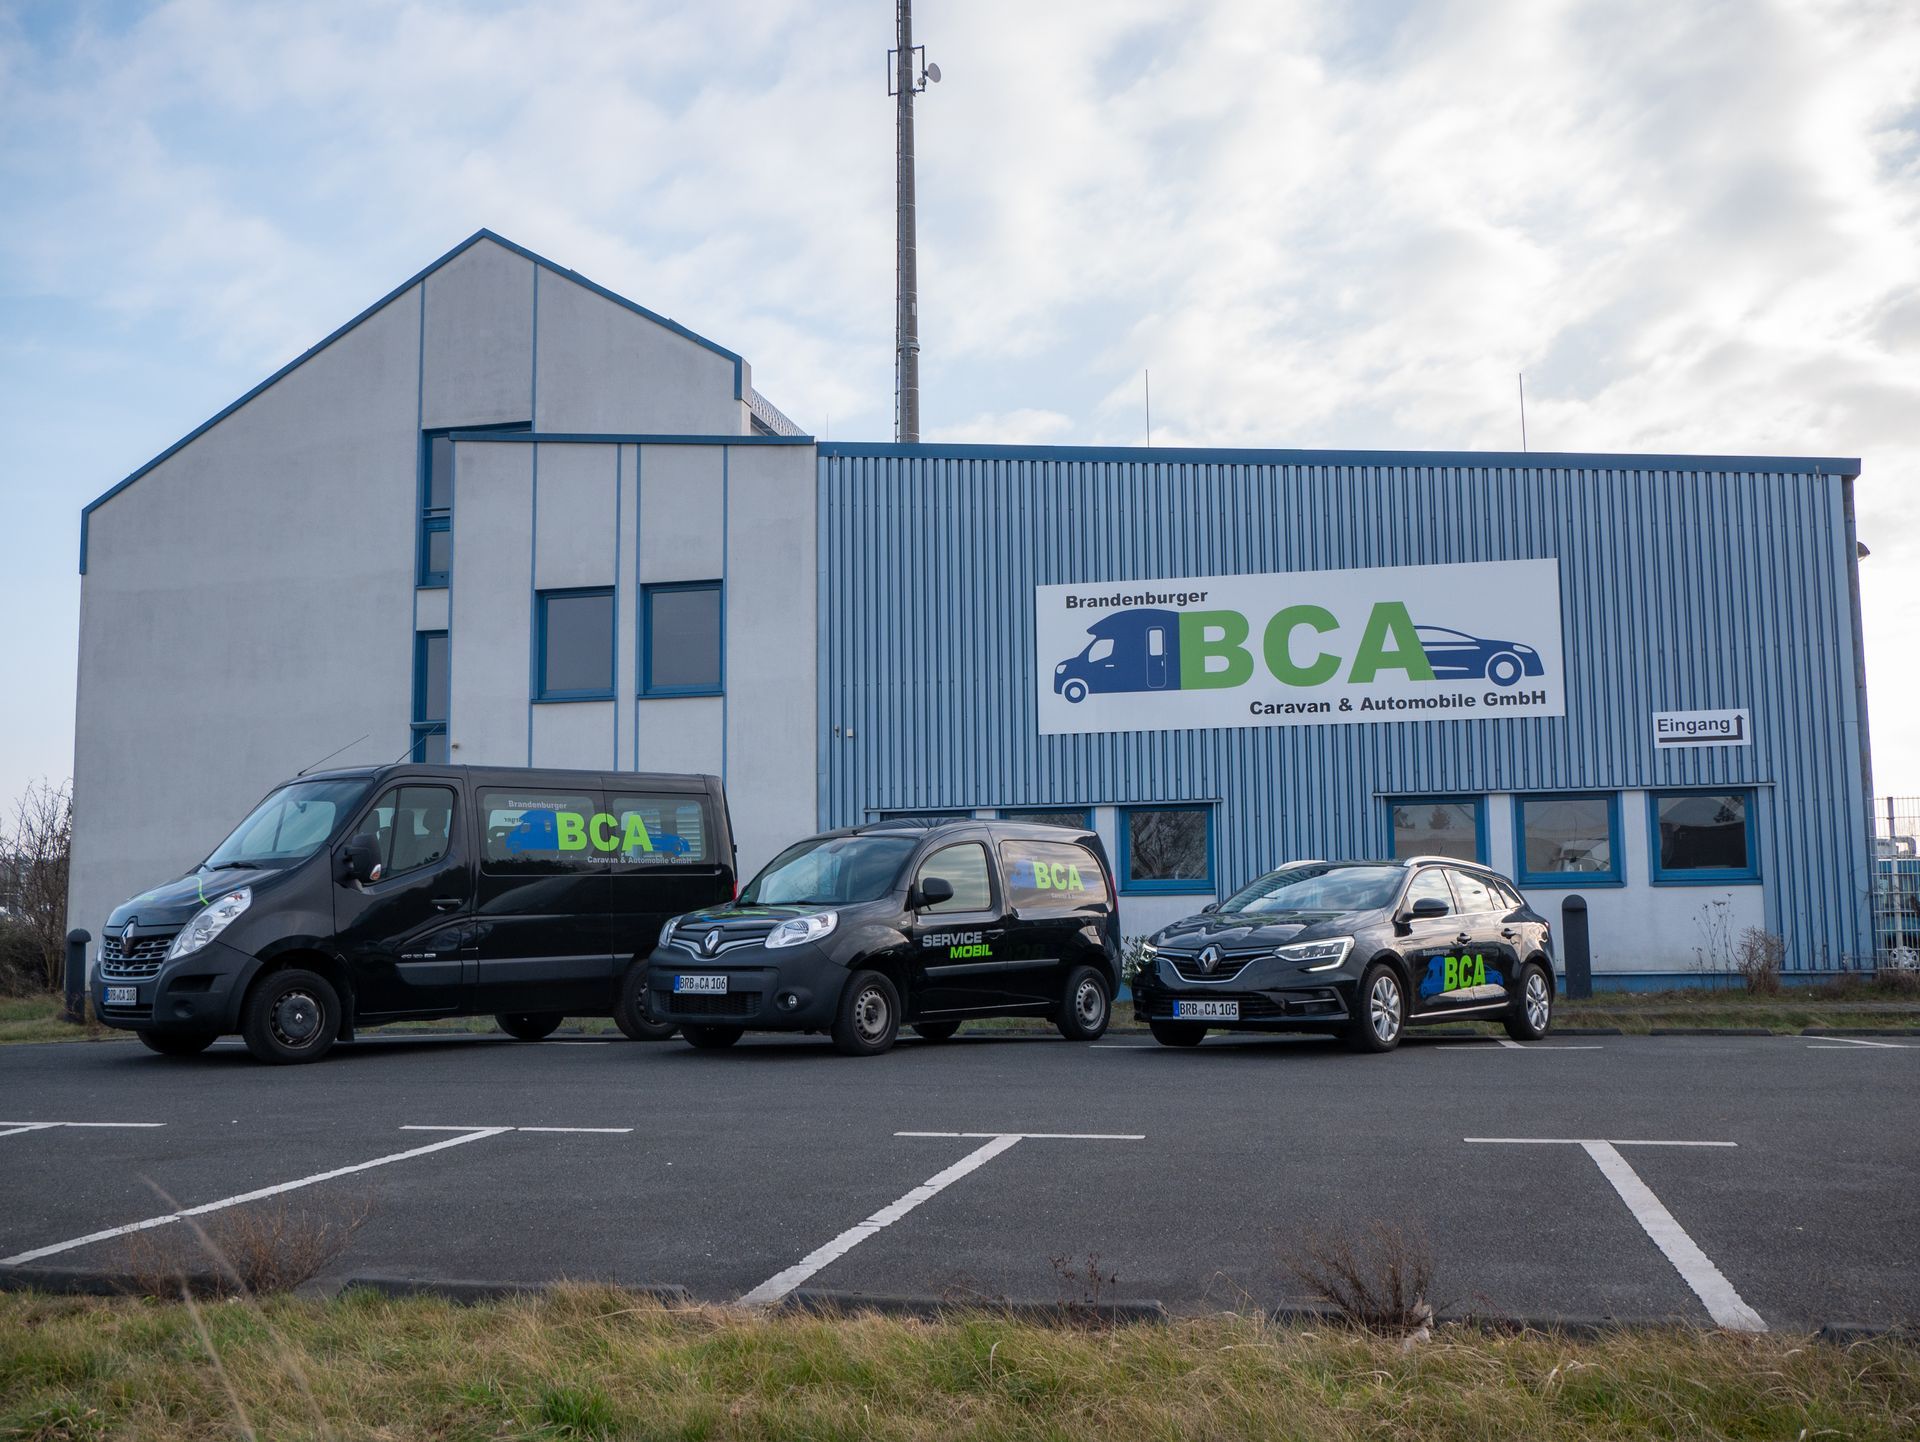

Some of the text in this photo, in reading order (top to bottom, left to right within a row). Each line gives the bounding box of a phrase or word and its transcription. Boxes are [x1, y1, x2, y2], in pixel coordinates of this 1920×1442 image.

[1065, 589, 1208, 610] Brandenburger
[1179, 601, 1436, 690] BCA
[1249, 691, 1547, 715] Caravan & Automobile GmbH
[1657, 718, 1730, 735] Eingang
[508, 800, 567, 810] Brandenburger
[556, 812, 654, 852] BCA
[587, 856, 618, 864] Caravan
[620, 856, 626, 864] &
[628, 856, 669, 864] Automobile
[1033, 861, 1084, 891] BCA
[922, 931, 982, 947] SERVICE
[950, 944, 993, 959] MOBIL
[1443, 954, 1486, 992] BCA
[680, 977, 726, 989] BRB CA 106
[1180, 1003, 1237, 1016] BRB CA 105
